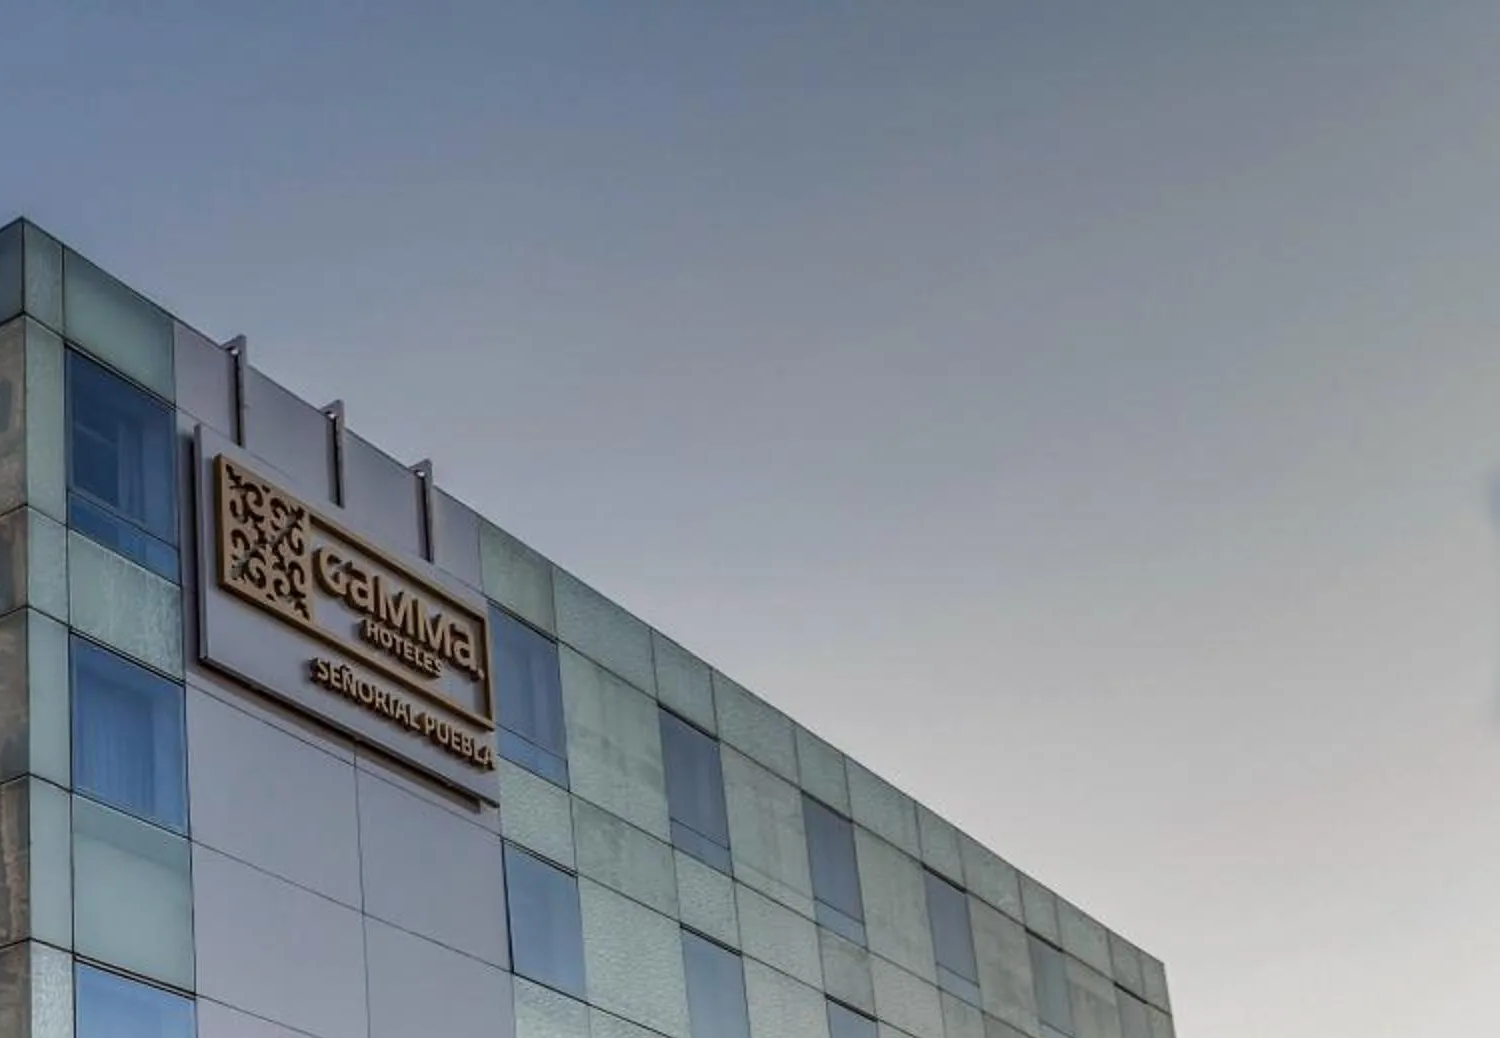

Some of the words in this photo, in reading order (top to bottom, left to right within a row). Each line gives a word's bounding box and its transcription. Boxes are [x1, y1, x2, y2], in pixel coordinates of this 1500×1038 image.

[362, 619, 443, 678] HOTELES
[309, 657, 422, 732] SEÑORIAL
[423, 712, 496, 770] PUEBLA
